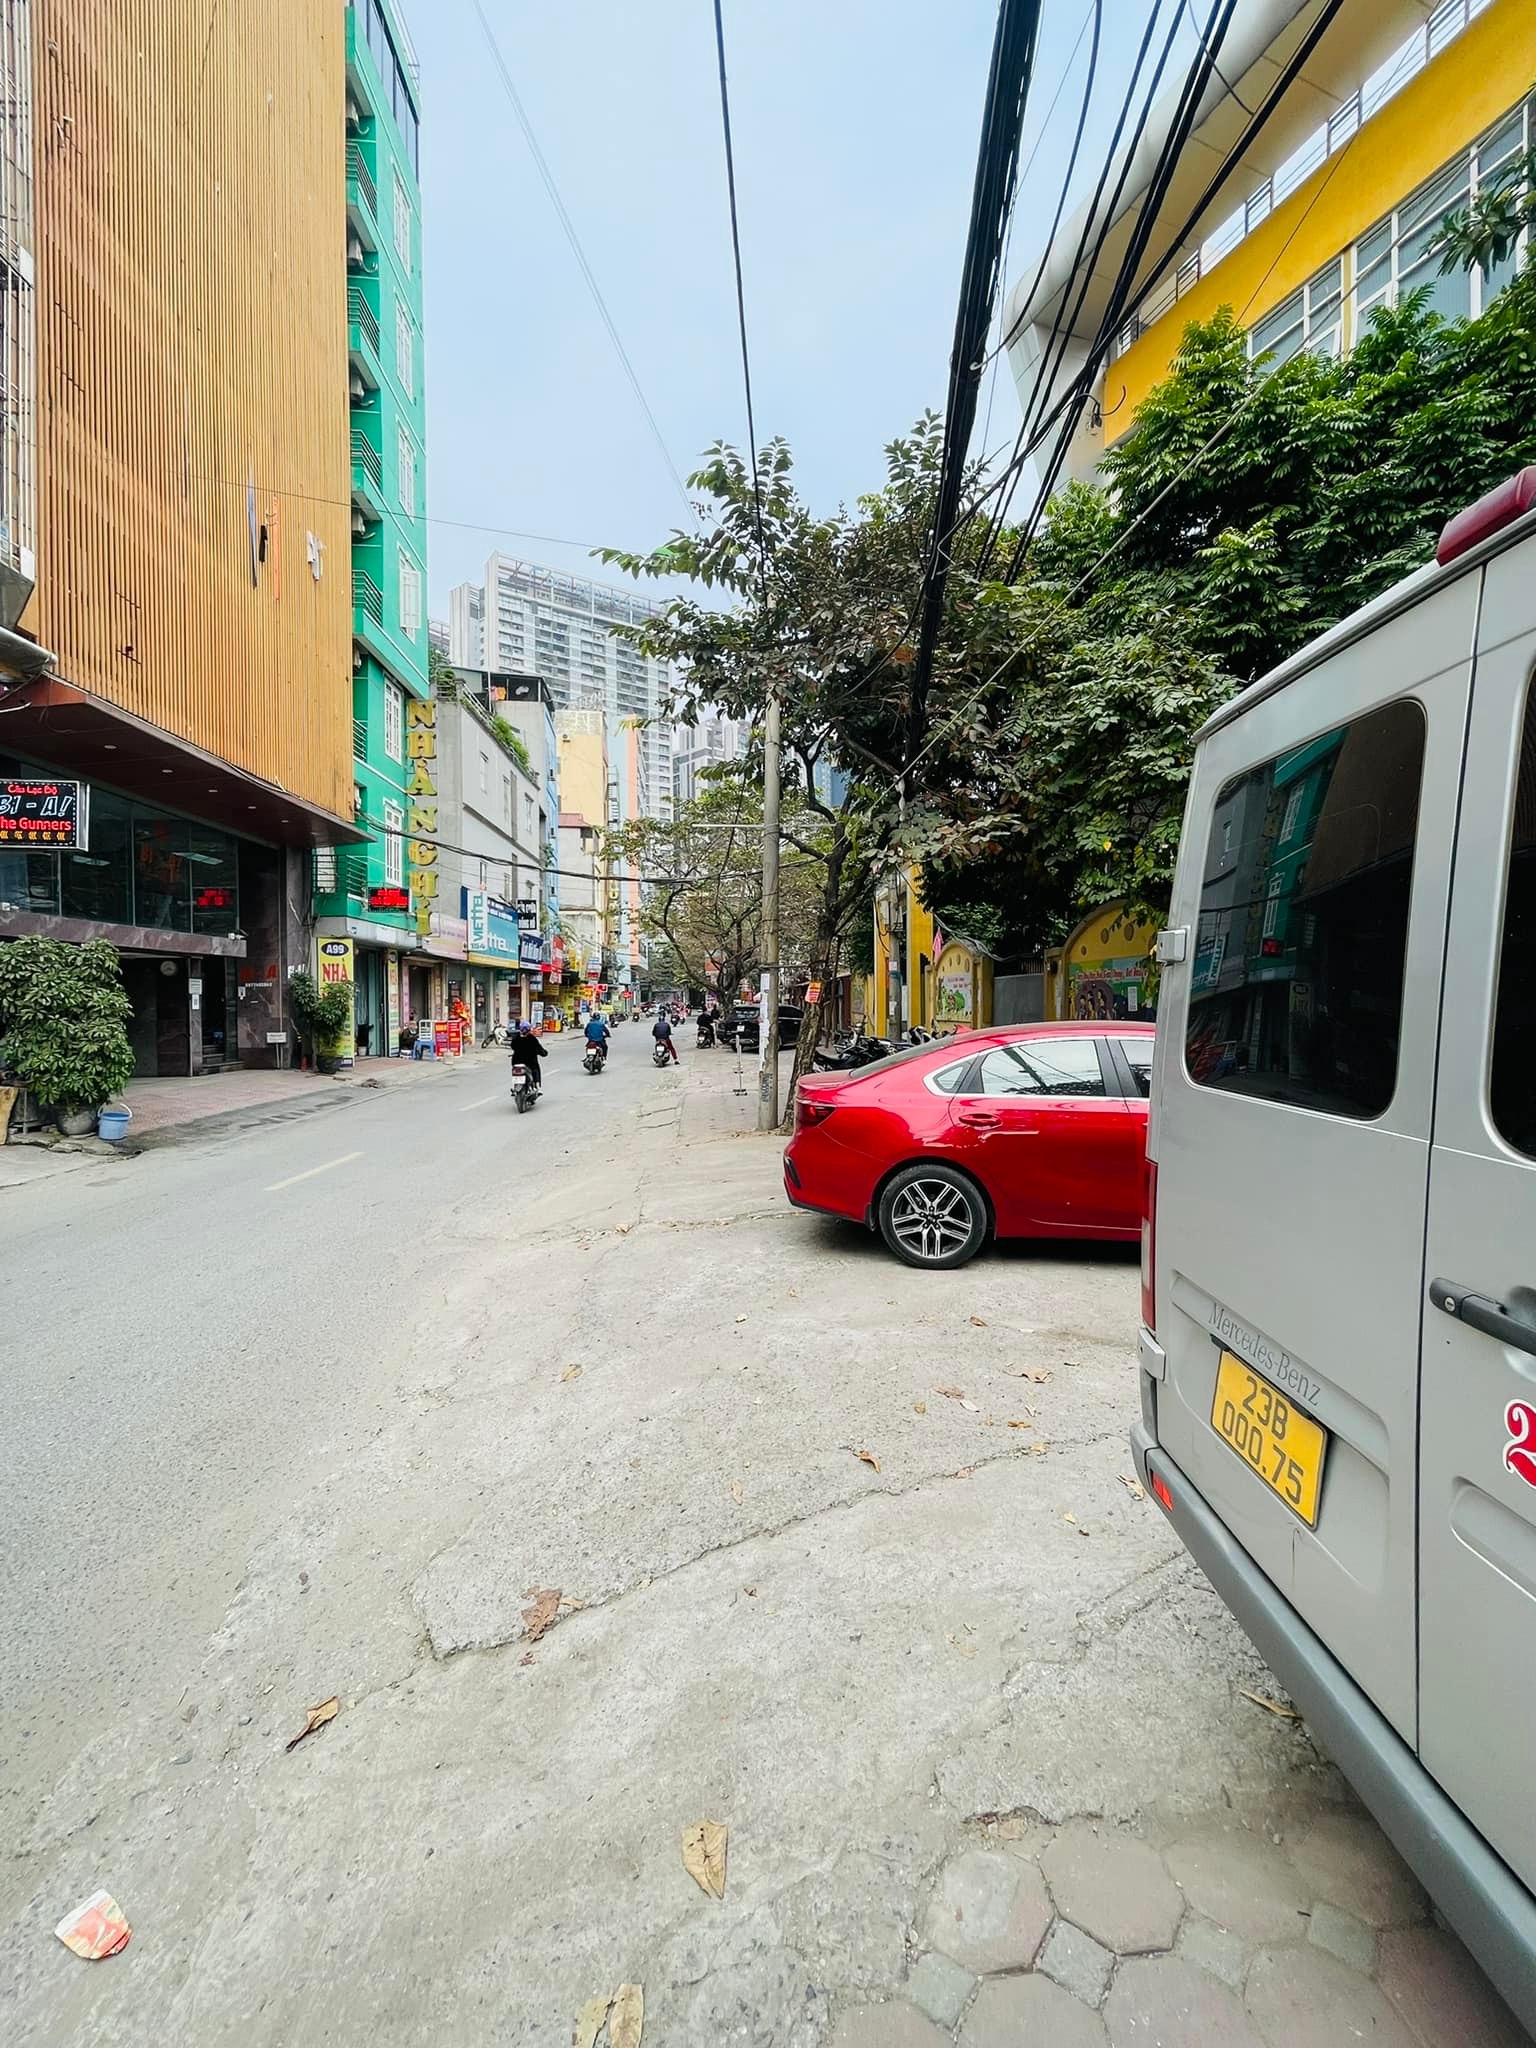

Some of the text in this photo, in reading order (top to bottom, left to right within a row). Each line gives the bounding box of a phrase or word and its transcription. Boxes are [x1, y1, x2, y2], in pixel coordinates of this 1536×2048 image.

[19, 817, 72, 831] Gunners
[322, 958, 349, 982] NHÀ
[326, 944, 345, 954] A99
[1208, 1302, 1321, 1407] Mercedes-Benz
[1242, 1375, 1288, 1440] 23B
[1221, 1400, 1304, 1505] 000.75
